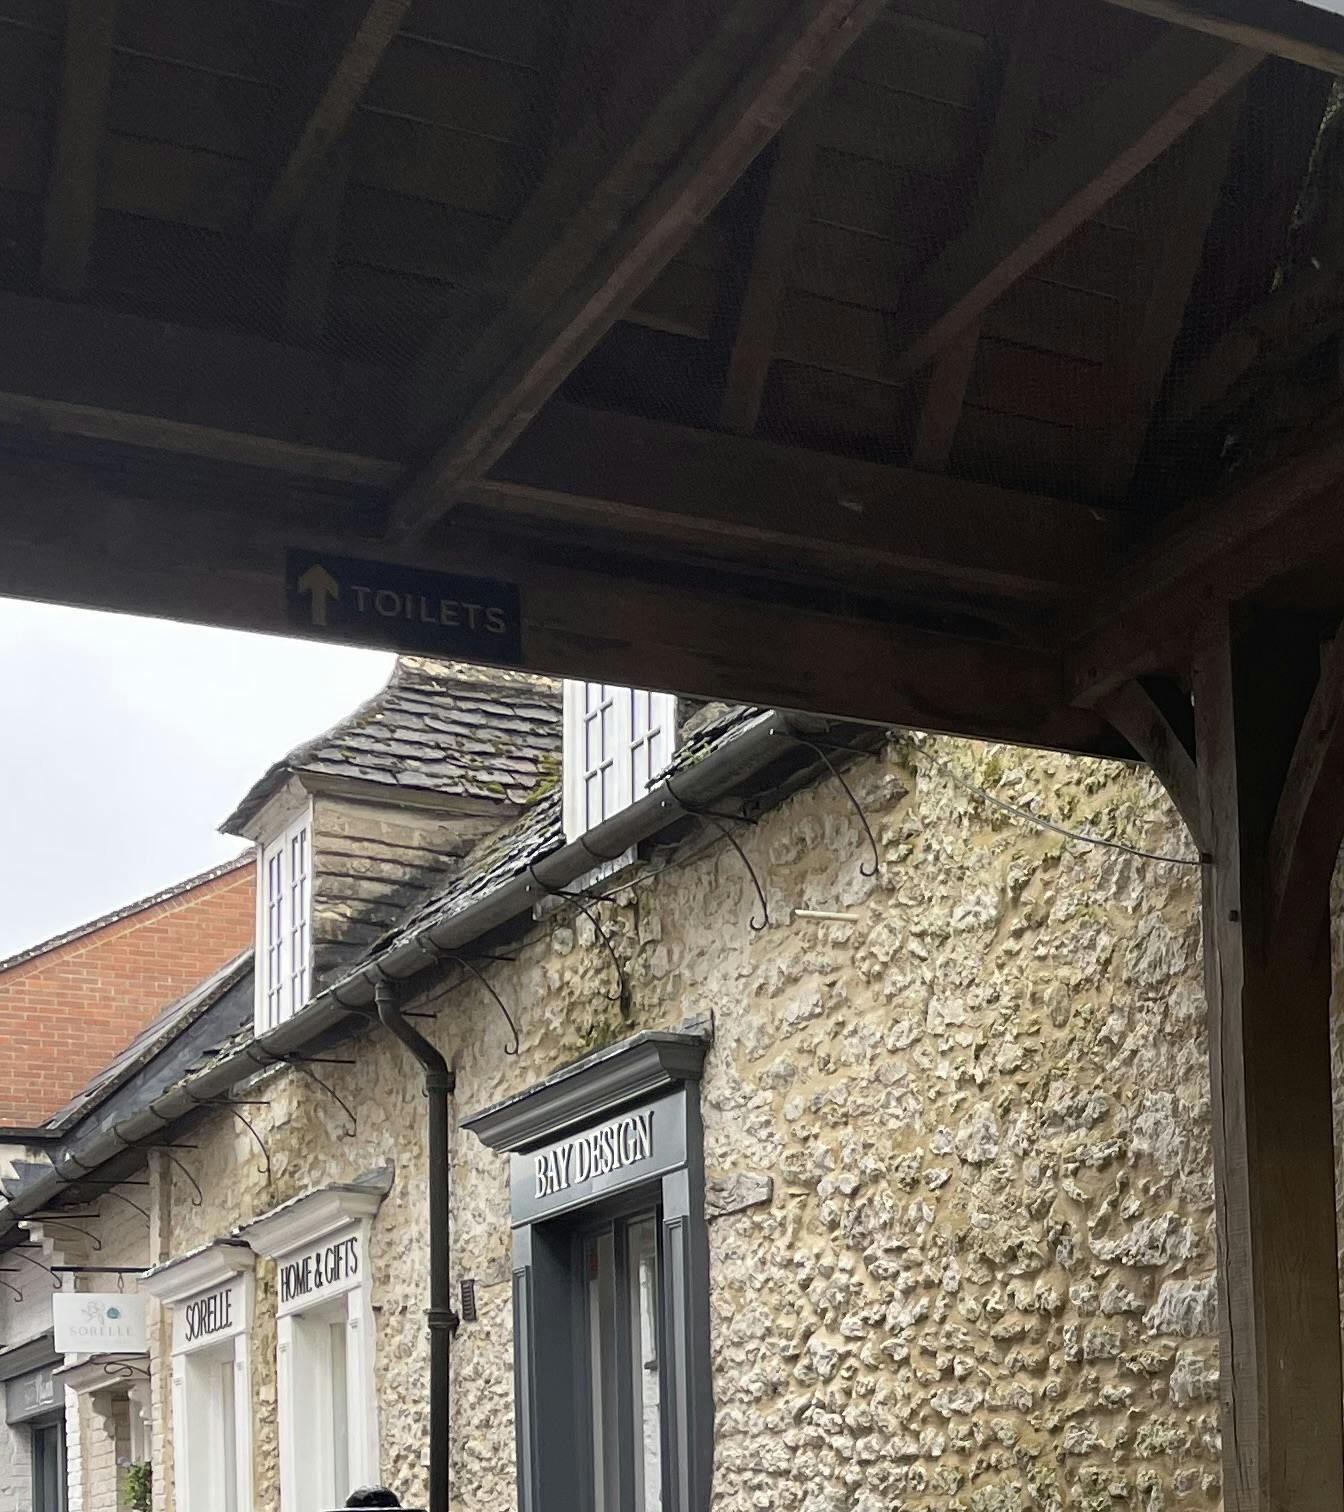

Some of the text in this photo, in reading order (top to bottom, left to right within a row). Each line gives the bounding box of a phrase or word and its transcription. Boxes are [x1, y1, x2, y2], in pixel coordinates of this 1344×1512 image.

[350, 585, 506, 633] TOILETS
[534, 1110, 655, 1199] BAY DESIGN
[280, 1236, 358, 1303] HOME & GIFTS
[185, 1289, 233, 1342] SORELLE
